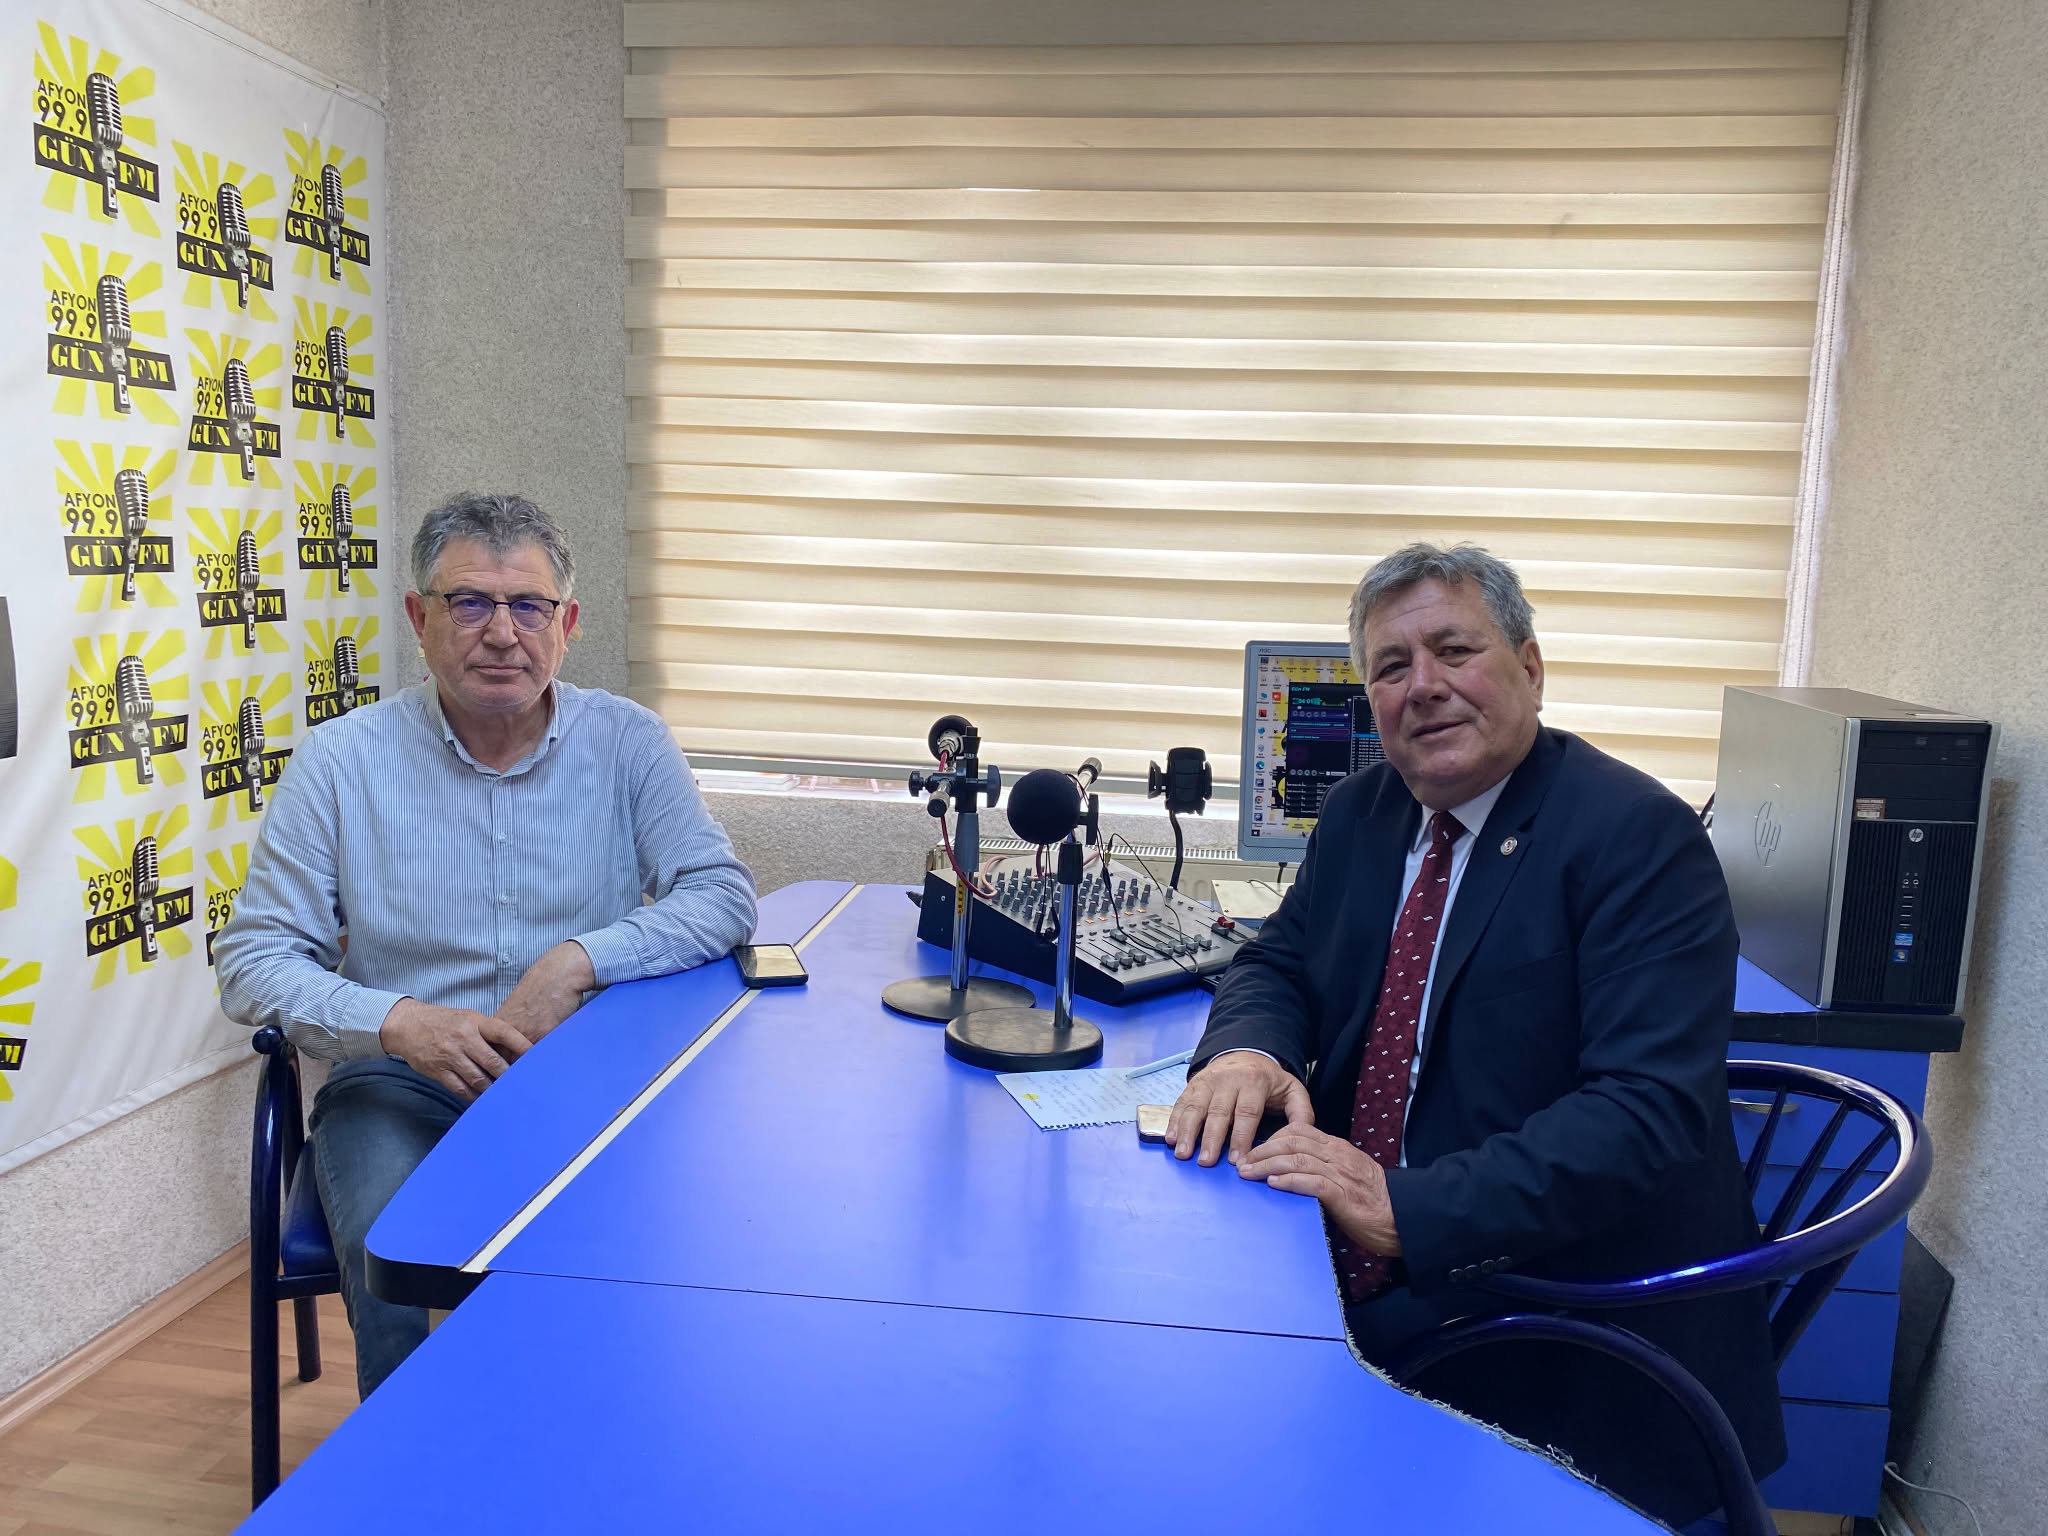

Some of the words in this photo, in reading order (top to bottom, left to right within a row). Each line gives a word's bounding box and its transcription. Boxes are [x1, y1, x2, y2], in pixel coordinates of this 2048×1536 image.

[38, 79, 86, 109] AFYON
[38, 95, 87, 135] 99.9
[38, 134, 95, 173] GÜN
[117, 160, 156, 193] FM
[180, 192, 217, 216] AFYON
[180, 207, 217, 239] 99.9
[287, 217, 325, 245] GÜN
[340, 233, 367, 258] FM
[180, 241, 227, 271] GÜN
[250, 257, 270, 282] FM
[51, 289, 97, 312] AFYON
[52, 306, 97, 338] 99.9
[296, 340, 326, 357] AFYON
[51, 342, 104, 373] GÜN
[128, 356, 170, 382] FM
[295, 353, 326, 378] 99.9
[197, 376, 223, 393] AFYON
[294, 381, 332, 406] GÜN
[346, 391, 371, 412] FM
[197, 391, 223, 416] 99.9
[191, 420, 231, 446] GÜN
[254, 429, 278, 450] FM
[64, 492, 116, 508] AFYON
[299, 502, 332, 515] AFYON
[66, 508, 118, 535] 99.9
[299, 515, 332, 536] 99.9
[70, 540, 125, 567] GÜN
[138, 544, 171, 565] FM
[197, 553, 237, 566] AFYON
[301, 541, 335, 563] GÜN
[349, 545, 374, 563] FM
[198, 567, 235, 590] 99.9
[202, 594, 239, 620] GÜN
[256, 596, 282, 615] FM
[307, 658, 334, 672] AFYON
[71, 683, 115, 701] AFYON
[308, 671, 334, 694] 99.9
[71, 698, 115, 727] 99.9
[308, 696, 338, 720] GÜN
[74, 729, 125, 759] GÜN
[152, 722, 185, 747] FM
[203, 722, 238, 740] AFYON
[203, 736, 238, 762] 99.9
[205, 763, 242, 791] GÜN
[1909, 828, 1924, 843] hp
[88, 867, 132, 891] AFYON
[88, 882, 132, 915] 99.9
[208, 887, 242, 907] AFYO
[90, 912, 135, 946] GÜN
[156, 895, 191, 923] FM
